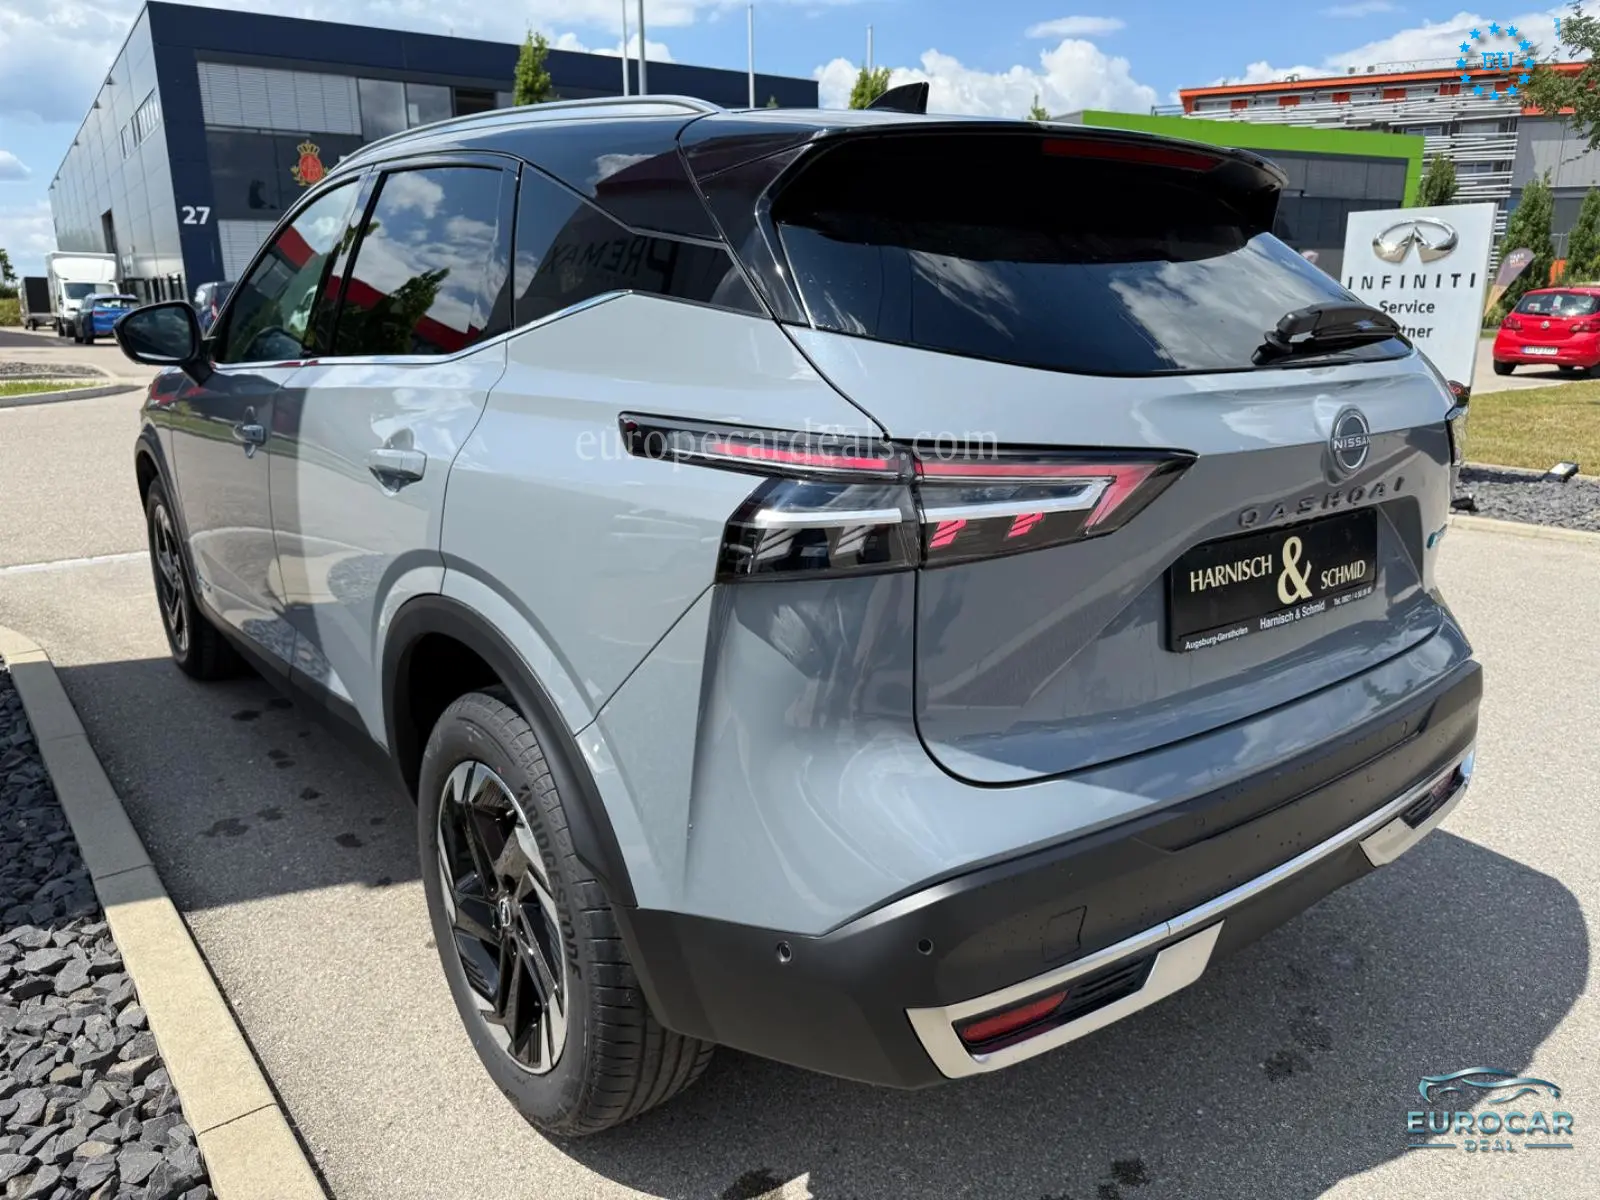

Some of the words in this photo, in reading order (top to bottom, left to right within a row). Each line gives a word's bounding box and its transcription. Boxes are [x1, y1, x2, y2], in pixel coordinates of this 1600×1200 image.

[182, 205, 210, 225] 27
[1348, 272, 1477, 290] INFINITI
[1379, 299, 1435, 314] Service
[1333, 435, 1370, 449] NISSAN
[1238, 476, 1405, 528] QASHQAI
[1190, 554, 1273, 592] HARNISCH
[1277, 536, 1313, 605] &
[1320, 560, 1366, 590] SCHMID
[1259, 610, 1294, 630] Harnisch
[1301, 600, 1325, 617] Schmid
